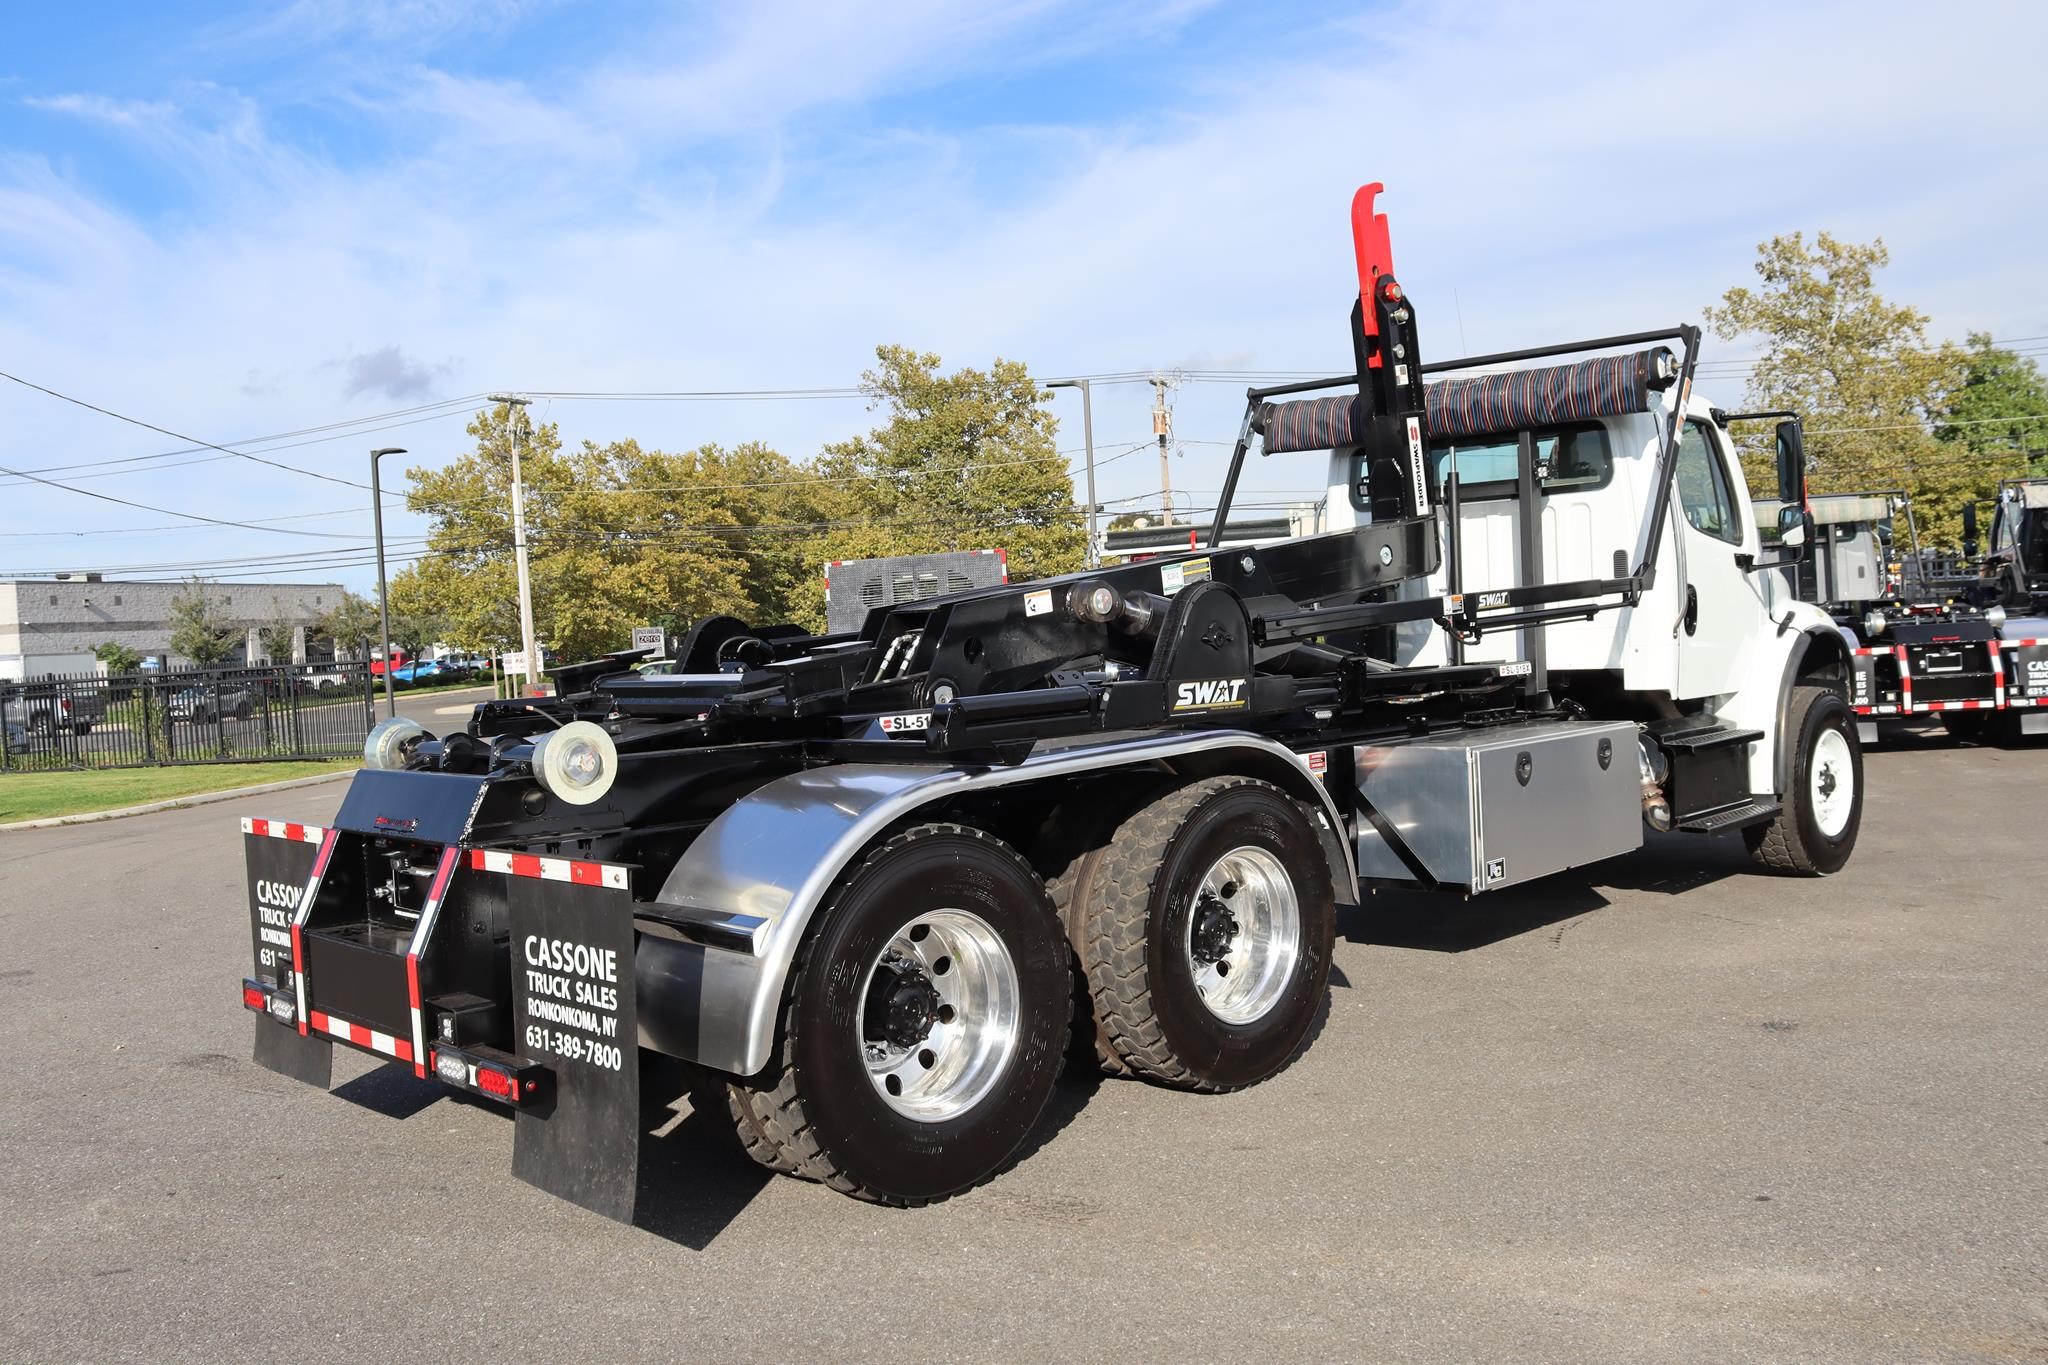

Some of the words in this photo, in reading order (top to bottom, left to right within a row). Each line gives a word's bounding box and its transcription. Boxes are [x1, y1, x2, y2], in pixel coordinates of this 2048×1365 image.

[1412, 443, 1424, 508] SWAPLOADER
[1478, 592, 1508, 607] SWAT
[1175, 679, 1246, 706] SWAT
[258, 906, 286, 928] TRUCK
[525, 935, 618, 983] CASSONE
[526, 970, 572, 1000] TRUCK
[575, 981, 618, 1011] SALES
[527, 997, 601, 1037] RONKONKOMA,
[602, 1015, 618, 1038] NY
[525, 1025, 622, 1072] 631-389-7800
